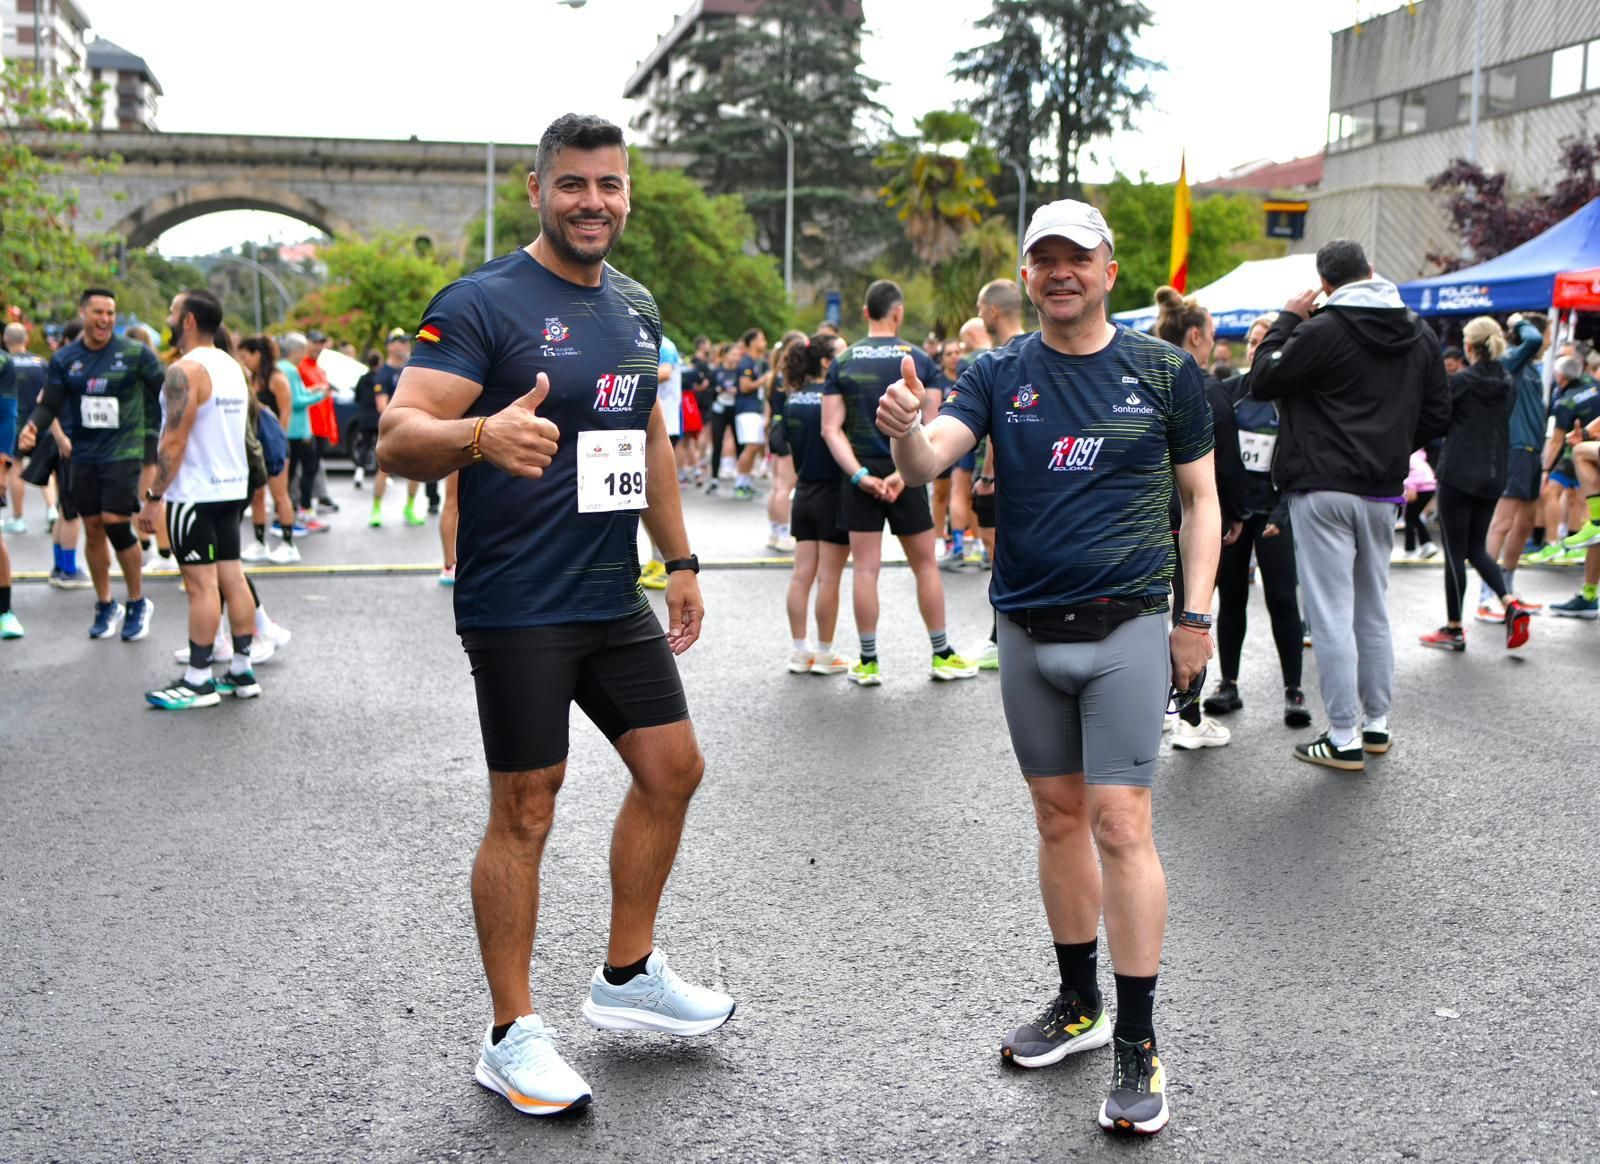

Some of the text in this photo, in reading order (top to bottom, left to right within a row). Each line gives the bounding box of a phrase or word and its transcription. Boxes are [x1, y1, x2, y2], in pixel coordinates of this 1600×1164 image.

[852, 351, 905, 360] NACIONA
[608, 374, 640, 407] 091
[1112, 404, 1154, 414] Santander
[1066, 437, 1105, 467] 091
[604, 471, 643, 496] 189
